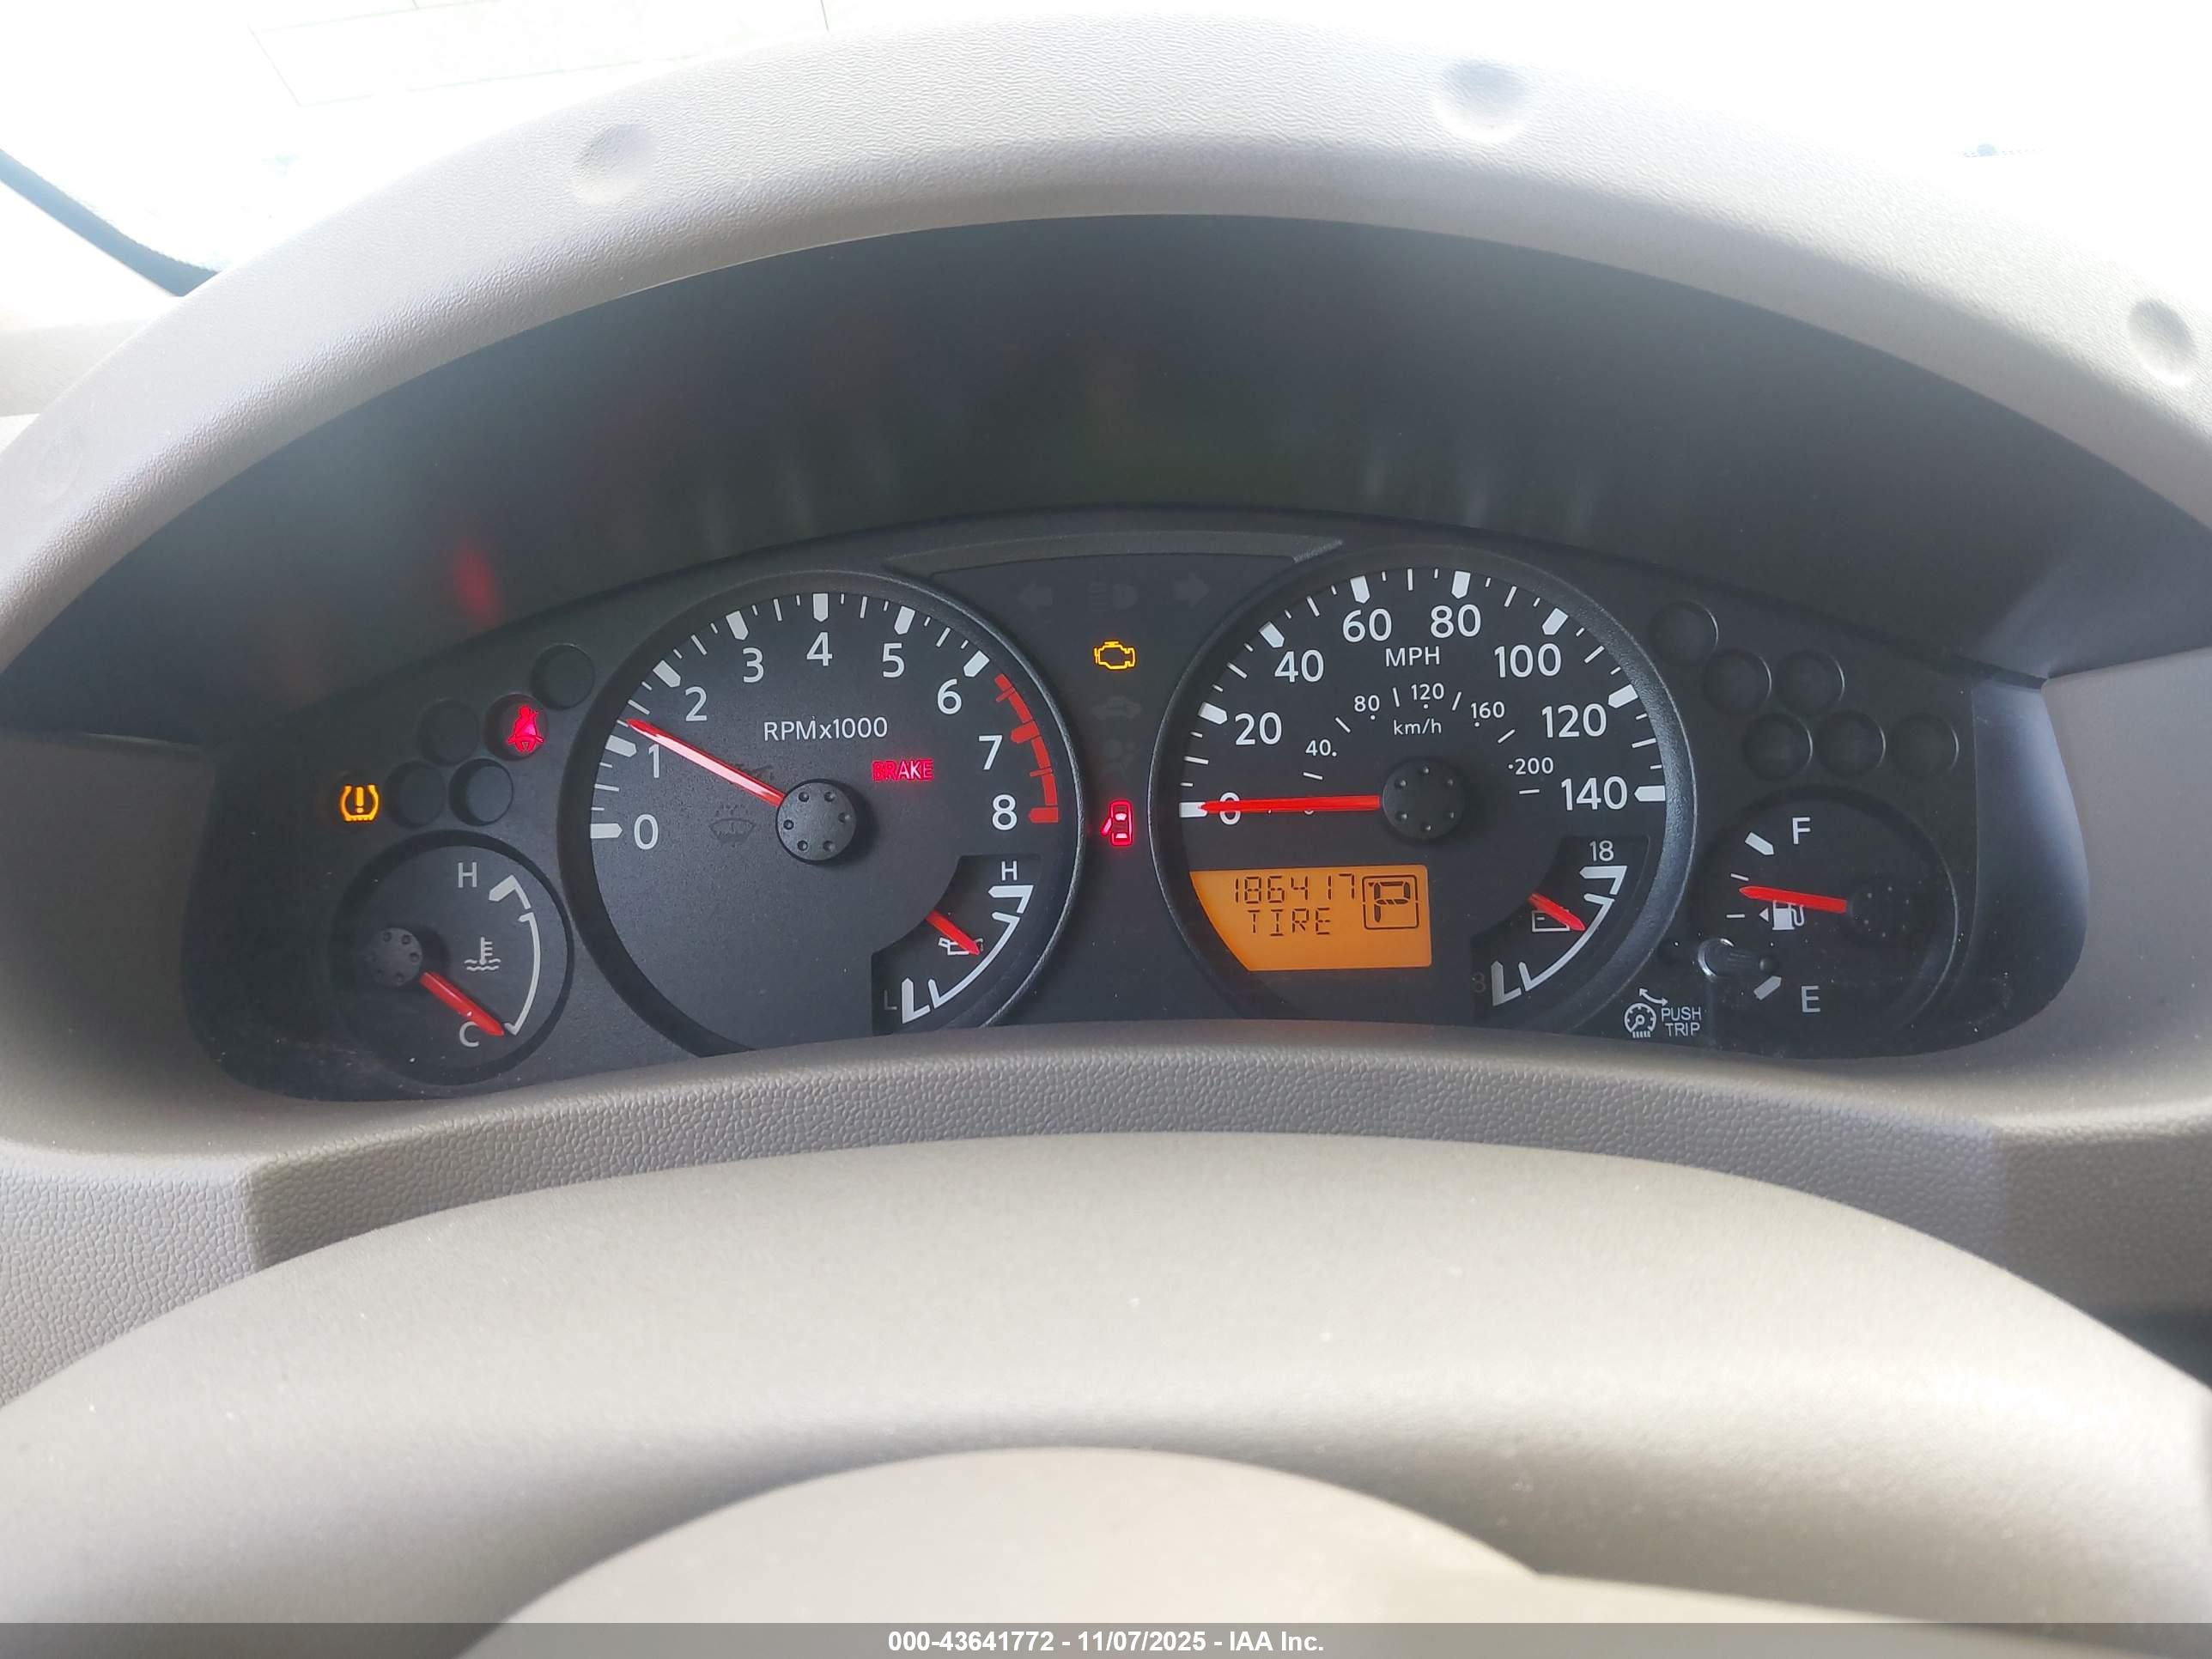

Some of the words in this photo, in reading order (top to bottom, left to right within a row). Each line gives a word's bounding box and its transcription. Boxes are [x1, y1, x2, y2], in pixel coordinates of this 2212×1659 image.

[1342, 609, 1392, 641] 60
[1430, 605, 1482, 638] 80
[806, 632, 832, 666] 4
[883, 643, 905, 678] 5
[1385, 647, 1441, 666] MPH
[1494, 643, 1562, 678] 100
[744, 647, 764, 683] 3
[1275, 650, 1325, 683] 40
[685, 687, 708, 722] 2
[937, 679, 962, 714] 6
[1354, 696, 1380, 713] 80
[1411, 684, 1444, 700] 120
[1471, 702, 1505, 719] 160
[1541, 704, 1607, 738] 120
[763, 717, 888, 741] RPMx1000
[1235, 713, 1282, 745] 20
[1393, 719, 1443, 735] km/h
[649, 744, 660, 777] 1
[979, 736, 1003, 769] 7
[872, 759, 933, 781] BRAKE
[1219, 792, 1242, 825] 0
[1561, 776, 1627, 811] 140
[992, 795, 1017, 830] 8
[634, 814, 658, 849] 0
[1793, 817, 1811, 845] F
[1589, 840, 1614, 861] 18
[458, 862, 477, 888] H
[1001, 861, 1017, 880] H
[1233, 873, 1356, 903] 186417
[1373, 881, 1410, 923] P
[1249, 908, 1330, 937] TIRE
[884, 992, 896, 1010] L
[1662, 1007, 1701, 1022] PUSH
[1802, 986, 1820, 1012] E
[459, 1021, 479, 1048] C
[1666, 1023, 1700, 1036] TRIP
